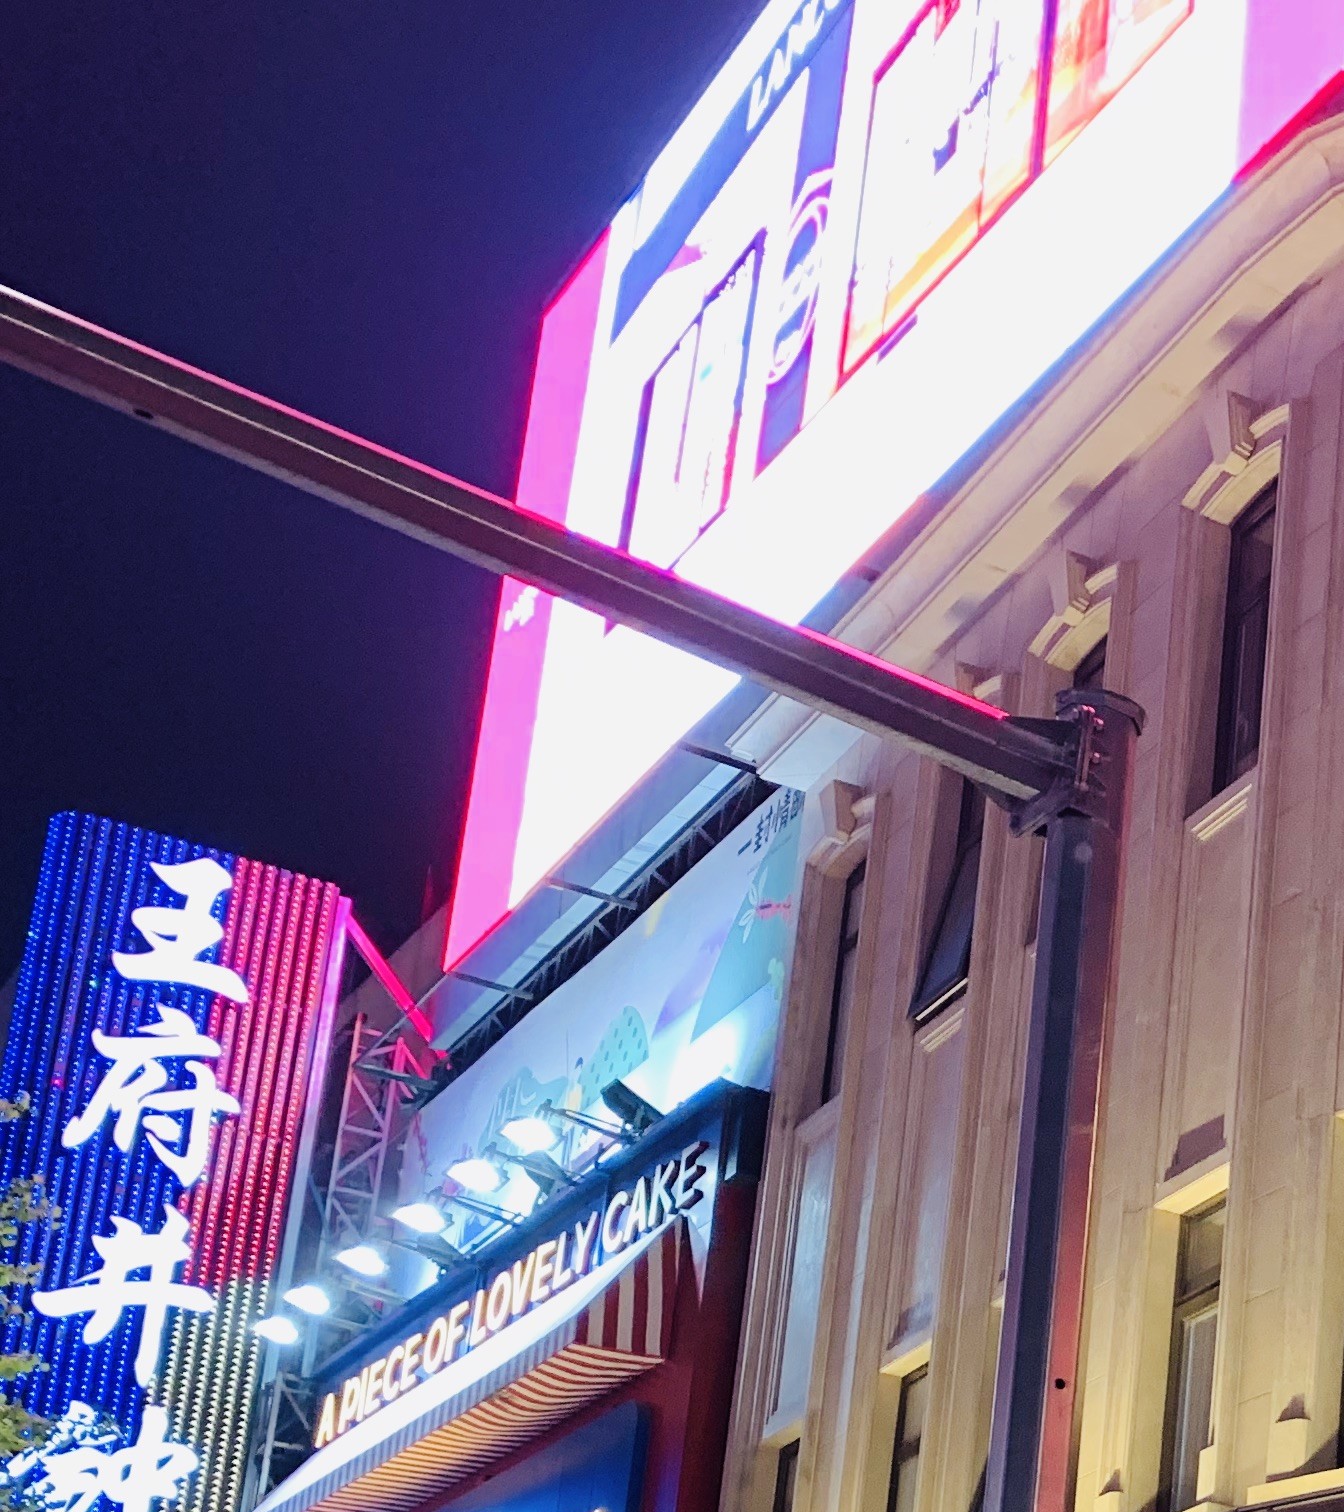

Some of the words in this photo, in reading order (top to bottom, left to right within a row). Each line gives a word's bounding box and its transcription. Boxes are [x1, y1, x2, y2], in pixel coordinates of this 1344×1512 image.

[746, 0, 843, 132] LAN
[315, 1392, 341, 1449] A
[338, 1332, 425, 1434] PIECE
[423, 1300, 471, 1374] OF
[468, 1211, 599, 1344] LOVELY
[602, 1140, 710, 1254] CAKE
